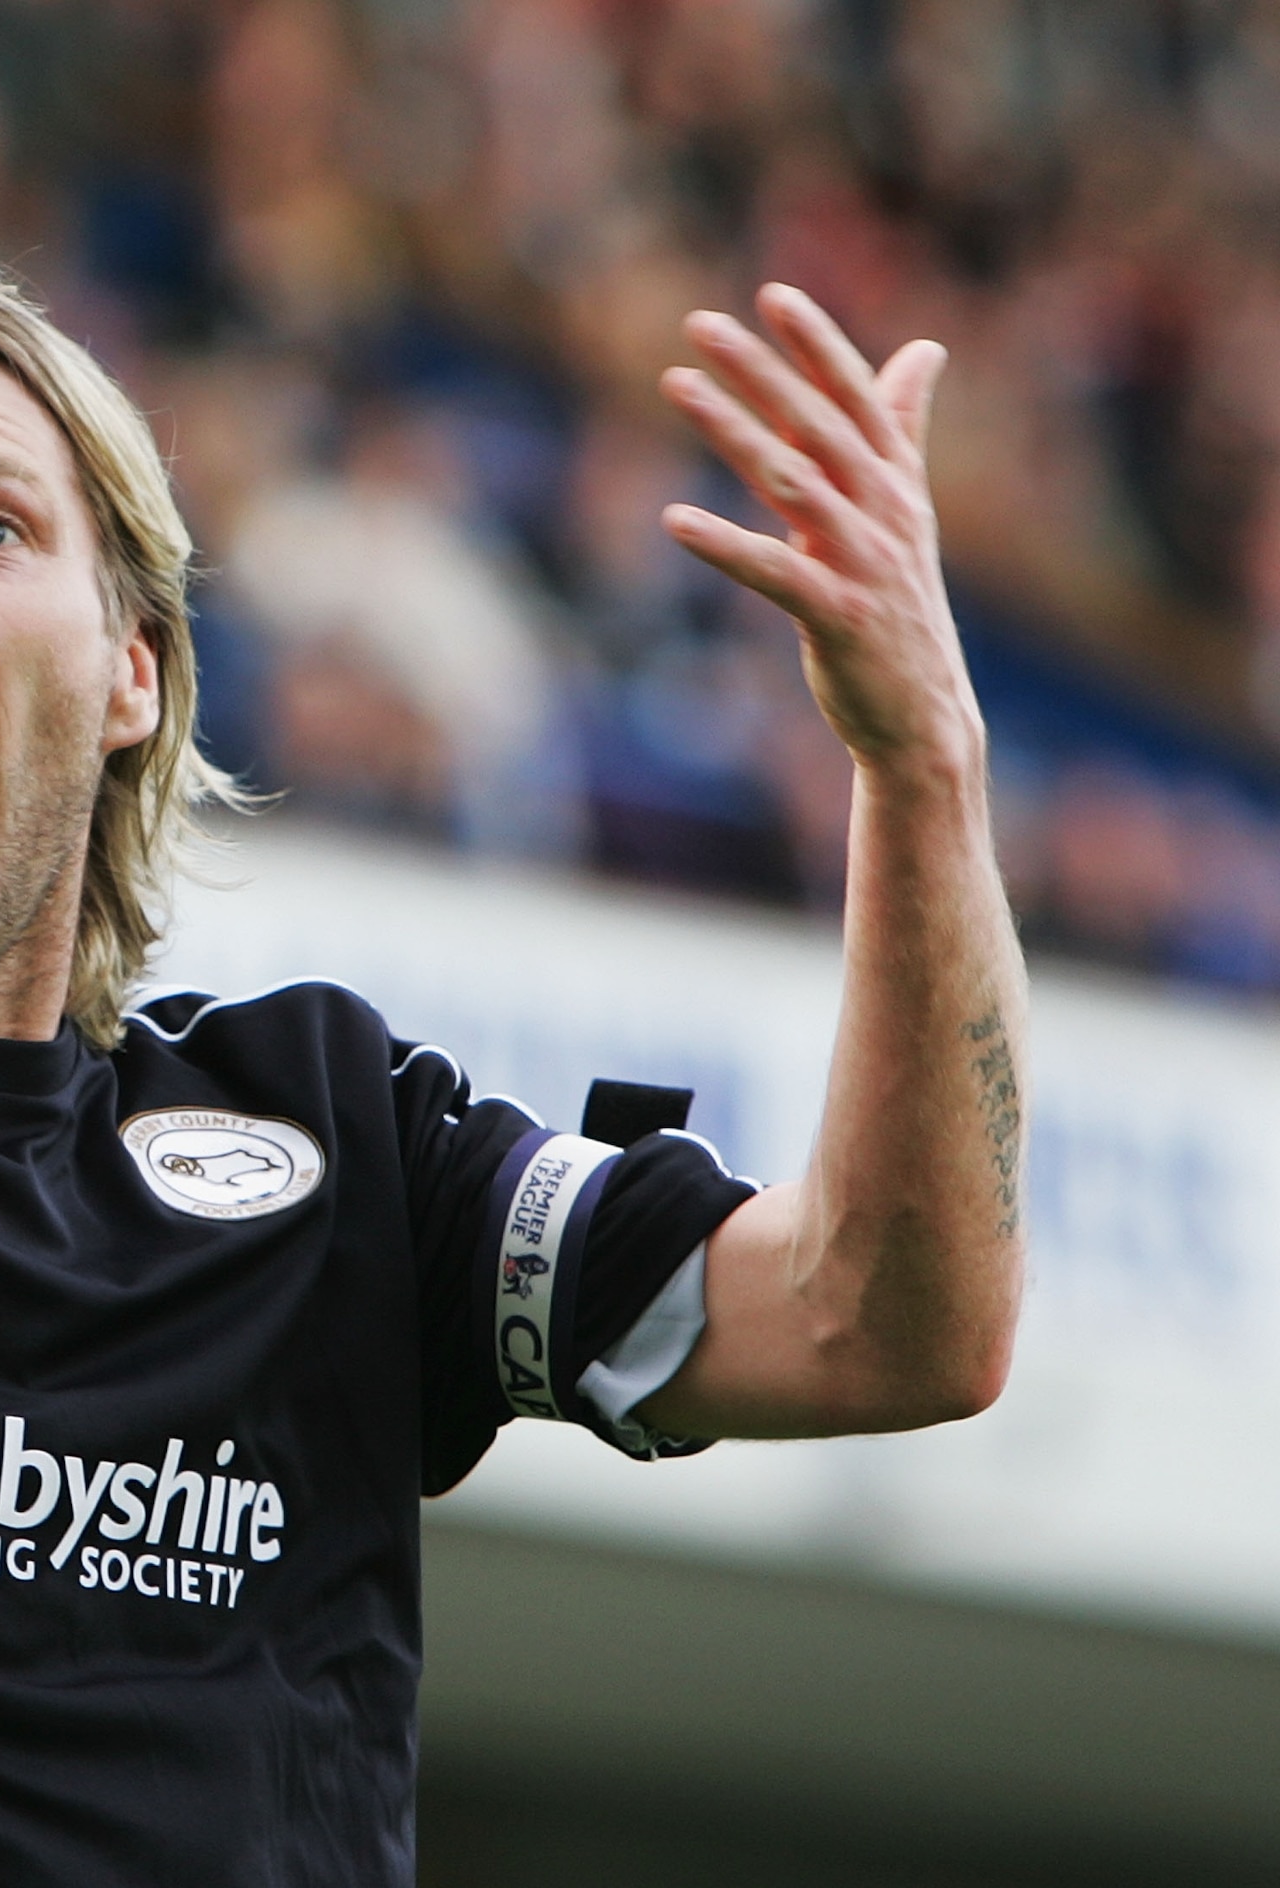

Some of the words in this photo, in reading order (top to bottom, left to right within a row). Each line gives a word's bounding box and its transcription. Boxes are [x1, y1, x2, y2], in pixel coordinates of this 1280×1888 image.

[169, 1114, 256, 1130] COUNTY
[510, 1157, 554, 1237] LEAGUE
[526, 1159, 572, 1245] PREMIER
[79, 1546, 244, 1608] SOCIETY
